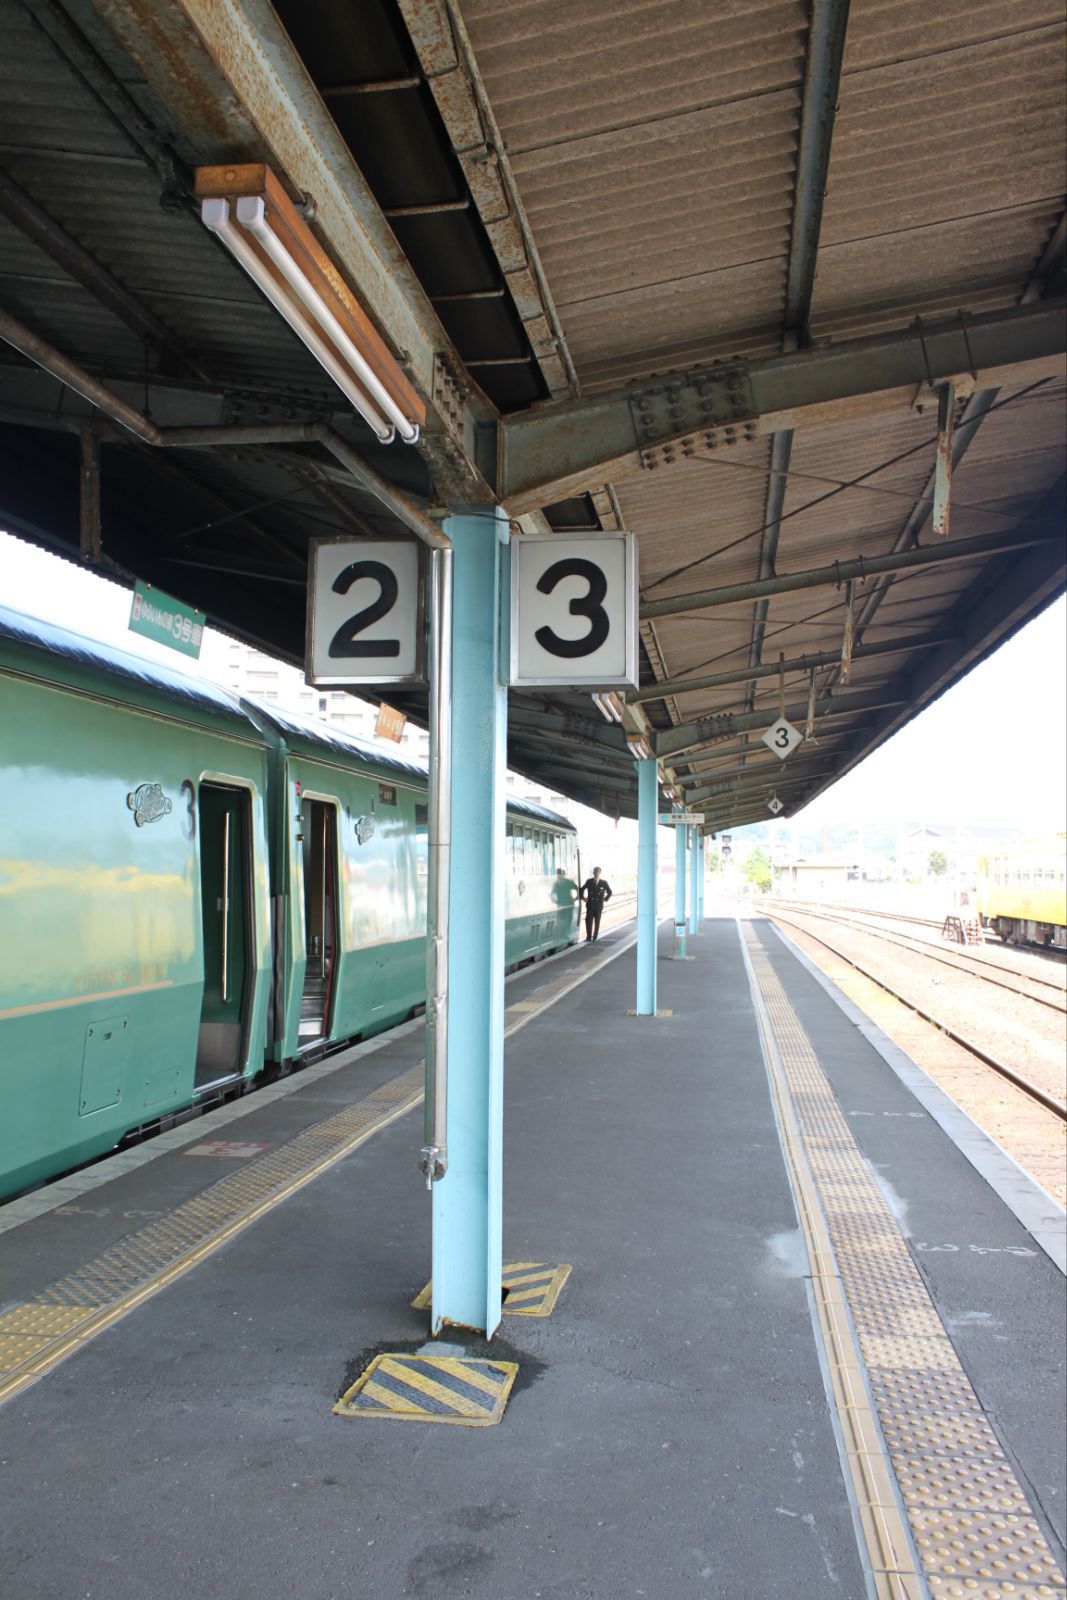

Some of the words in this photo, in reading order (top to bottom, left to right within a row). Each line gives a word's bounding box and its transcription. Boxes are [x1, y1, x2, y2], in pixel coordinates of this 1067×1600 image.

[328, 560, 399, 659] 2
[534, 557, 610, 659] 3
[775, 727, 790, 748] 3
[179, 779, 196, 841] 3
[772, 801, 778, 810] 4
